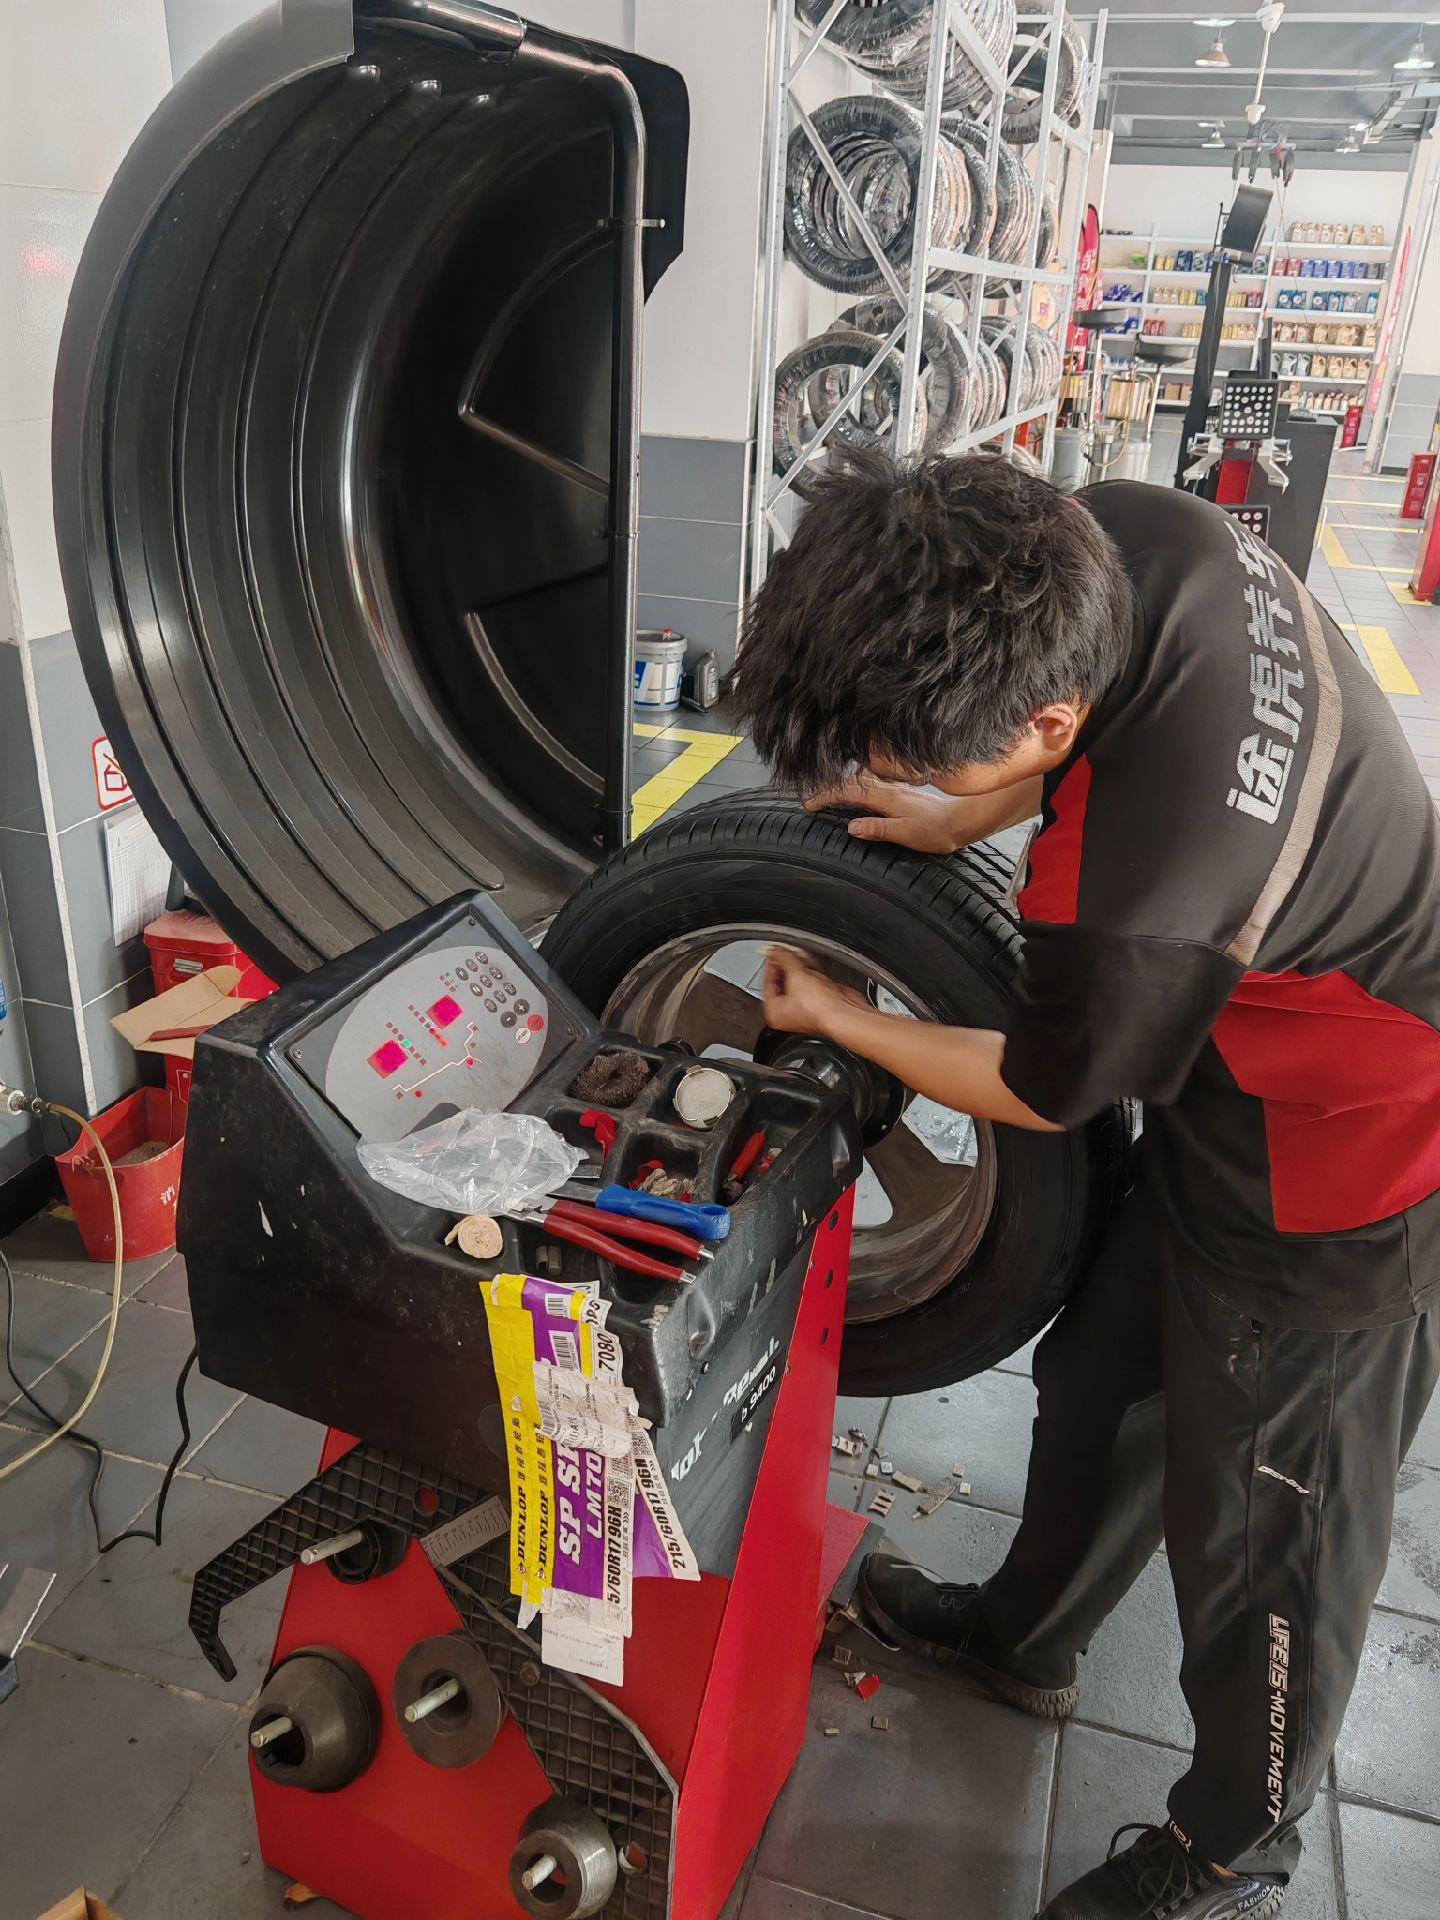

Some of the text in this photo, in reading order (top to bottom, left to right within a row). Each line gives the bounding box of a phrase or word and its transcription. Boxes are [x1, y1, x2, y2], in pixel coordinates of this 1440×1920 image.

[1224, 520, 1305, 825] 途虎养车
[598, 1333, 616, 1373] 7080
[586, 1451, 604, 1539] LM70
[634, 1458, 655, 1489] 96H
[517, 1486, 528, 1560] DUNLOP
[538, 1490, 549, 1566] DUNLOP
[559, 1496, 581, 1566] SP
[607, 1505, 622, 1538] 96H
[646, 1491, 686, 1569] 215/60R17
